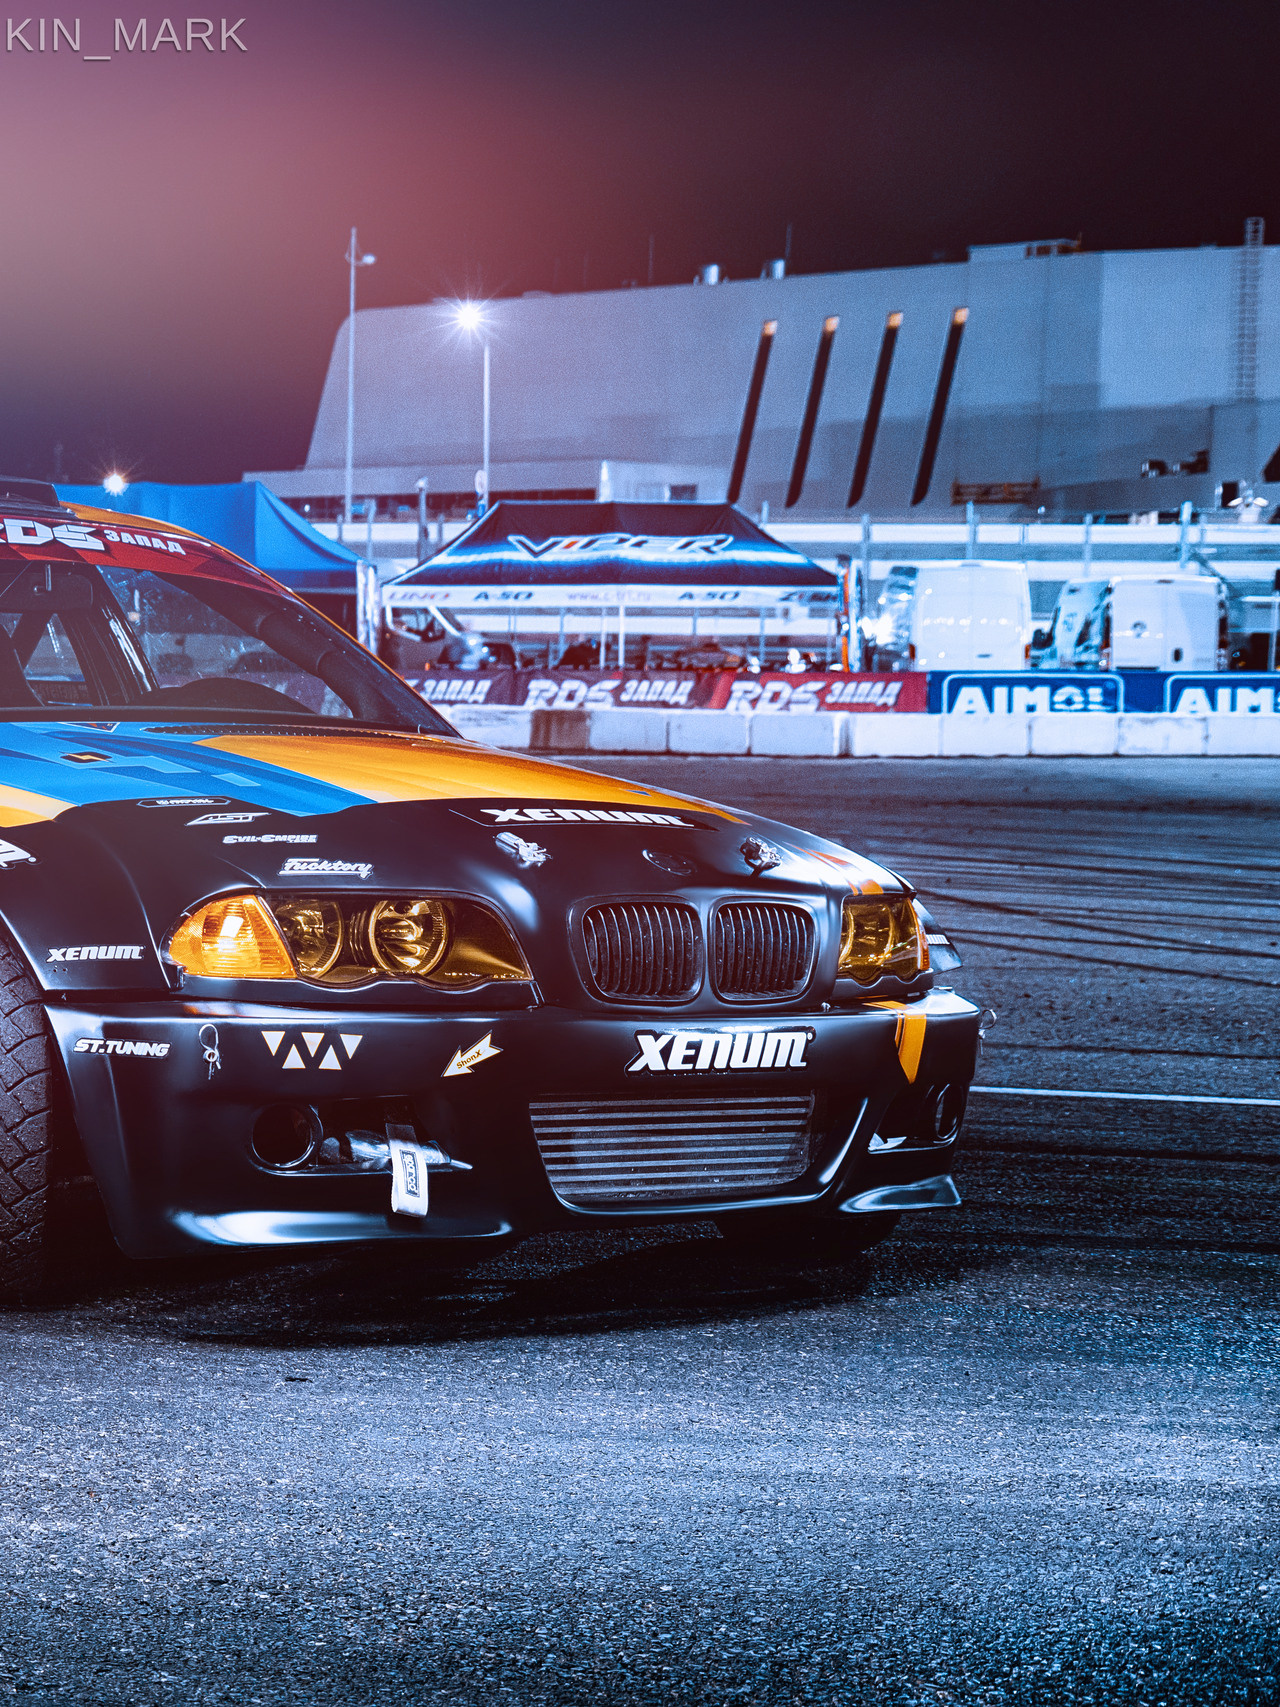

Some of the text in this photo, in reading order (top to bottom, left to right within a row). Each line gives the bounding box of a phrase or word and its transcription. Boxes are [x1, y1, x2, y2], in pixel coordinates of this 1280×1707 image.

[104, 529, 187, 556] ЗАПАД
[522, 679, 621, 709] RDS
[724, 680, 828, 713] RDS
[949, 685, 1113, 714] AIMOL
[1173, 686, 1280, 714] AIM
[479, 808, 695, 827] XENUM
[47, 945, 144, 962] XENUM
[73, 1038, 170, 1058] ST.TUNING
[456, 1049, 482, 1069] ShonX
[627, 1031, 810, 1073] XENUM
